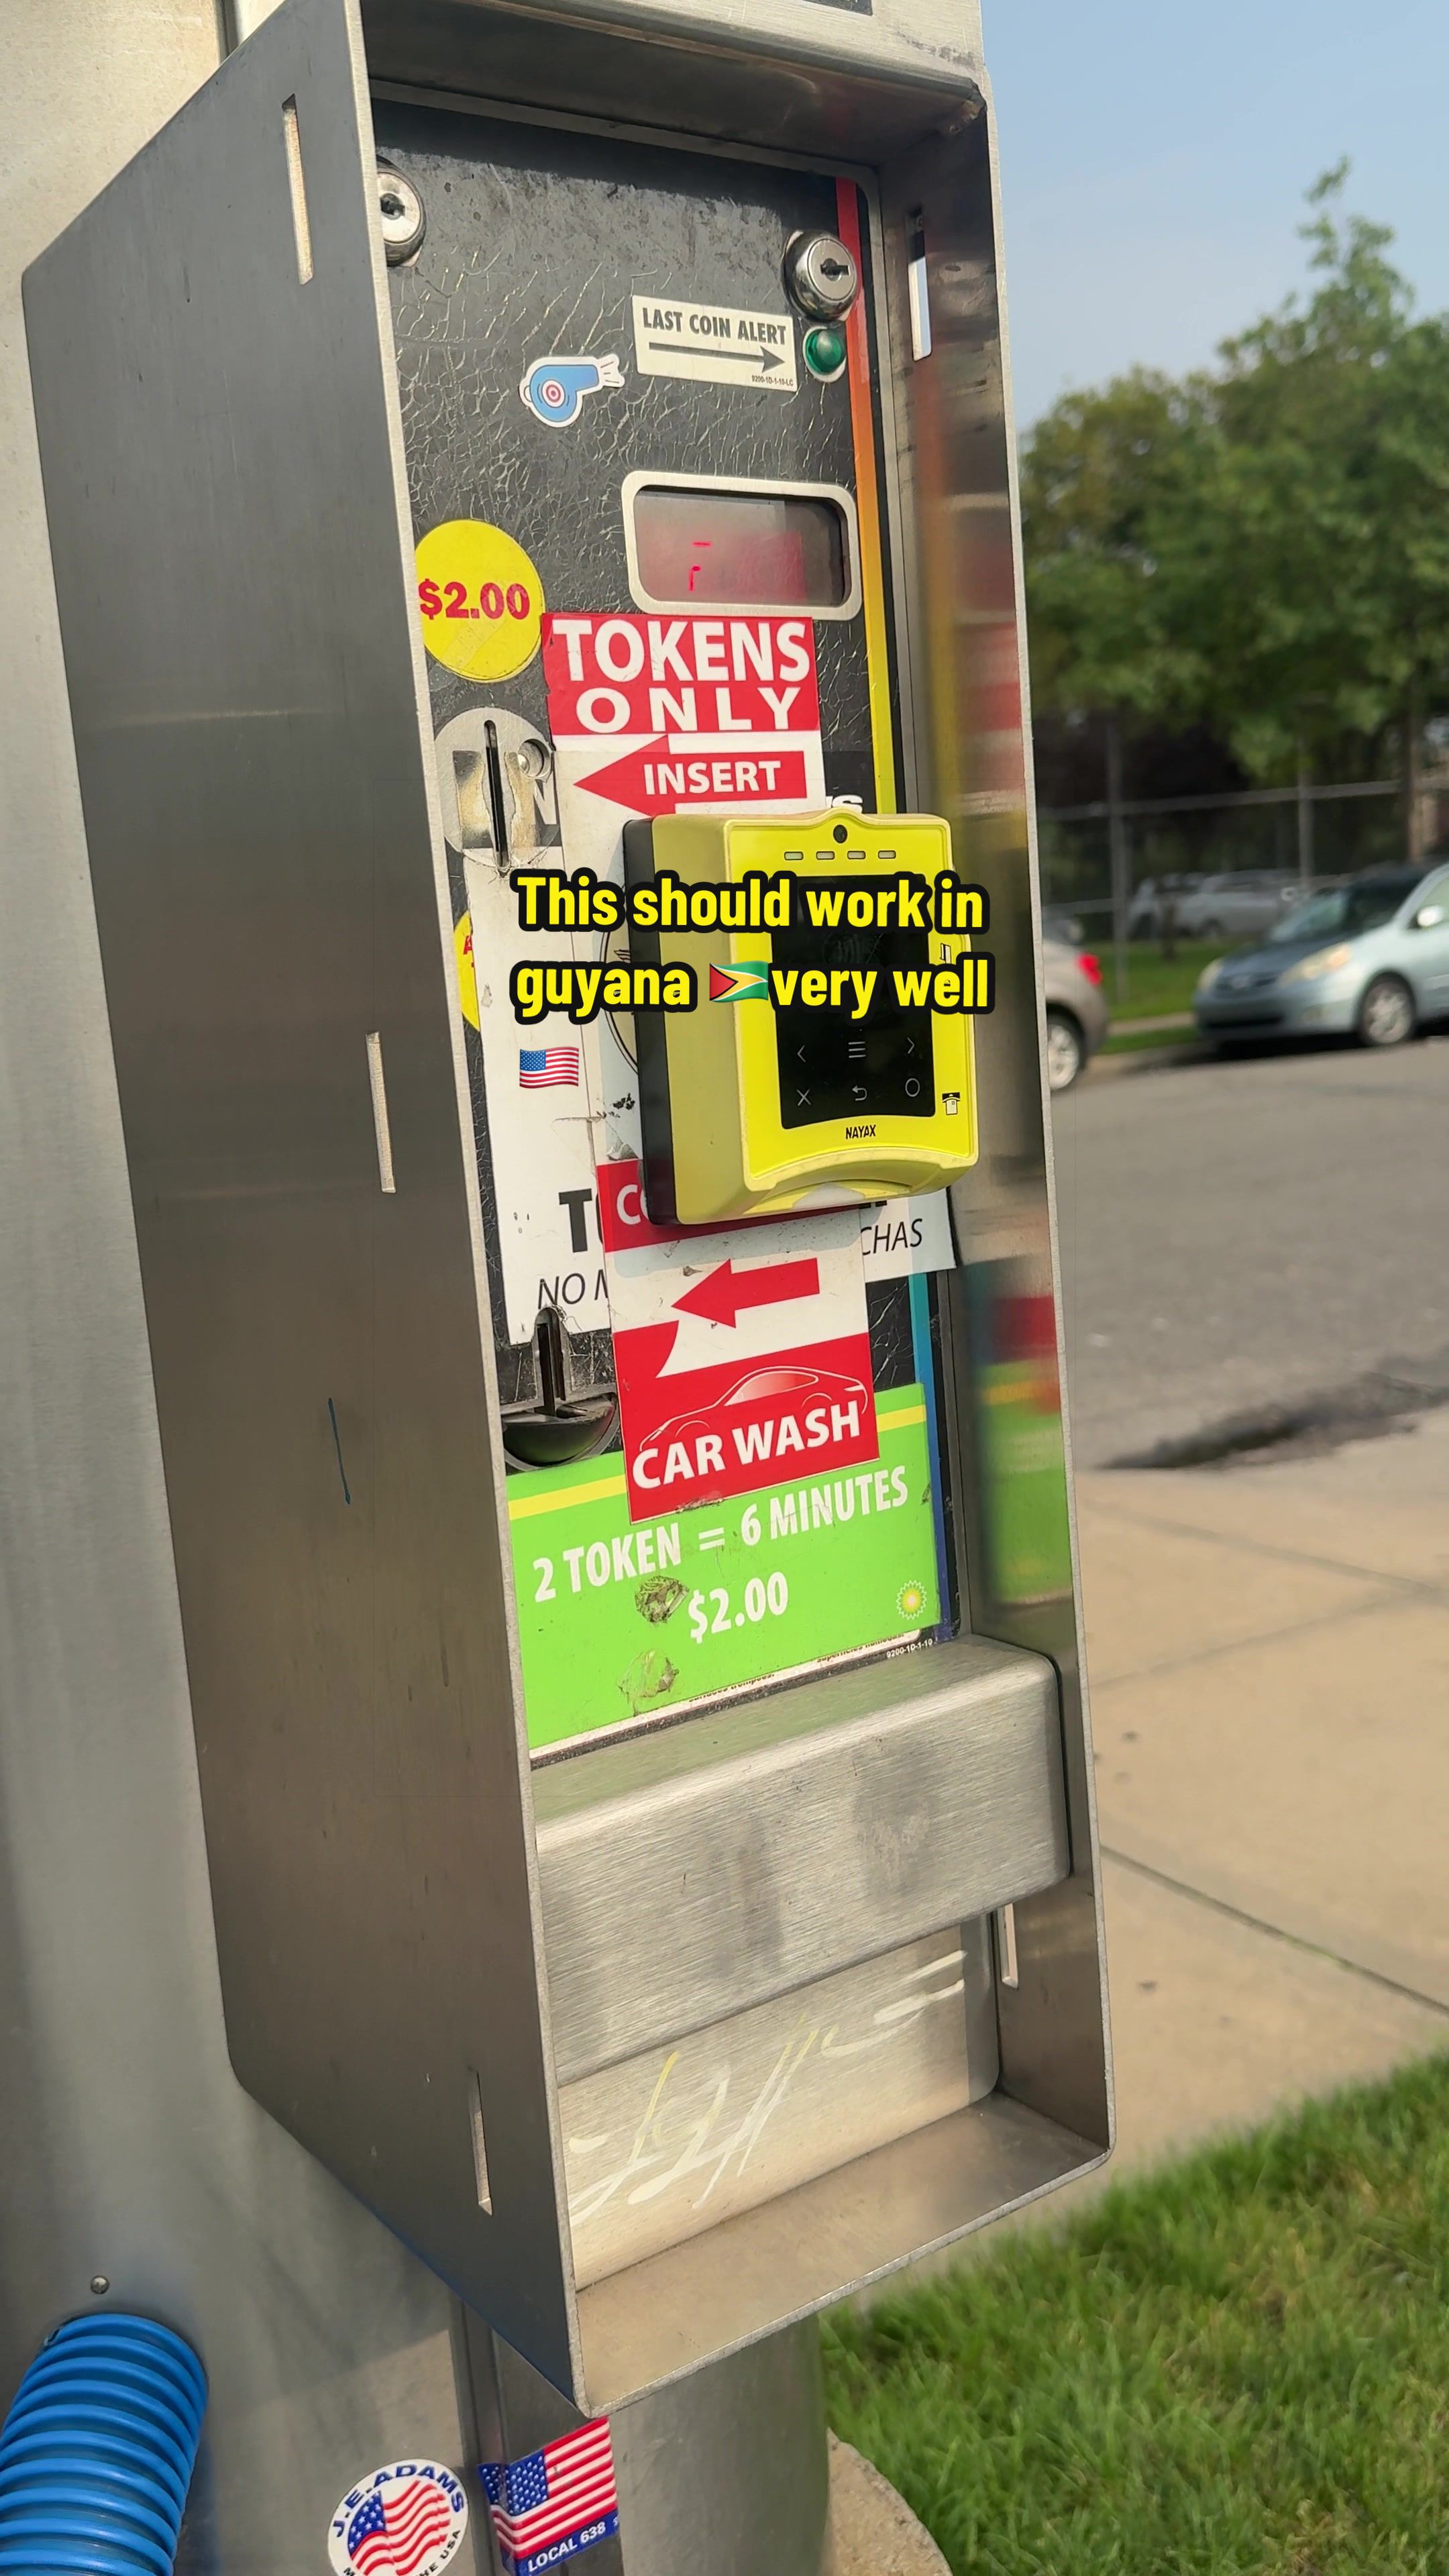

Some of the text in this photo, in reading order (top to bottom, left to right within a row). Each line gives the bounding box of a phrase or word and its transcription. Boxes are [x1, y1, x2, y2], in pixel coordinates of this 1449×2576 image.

[643, 307, 786, 345] LAST COIN ALERT
[418, 578, 530, 620] $2.00
[552, 619, 810, 683] TOKENS
[576, 687, 801, 734] ONLY
[643, 761, 782, 796] INSERT
[845, 1124, 876, 1140] NAYAX
[538, 1273, 586, 1309] NO
[633, 1400, 861, 1489] CAR WASH
[533, 1558, 556, 1603] 2
[564, 1523, 681, 1593] TOKEN
[741, 1504, 761, 1546] 6
[769, 1466, 908, 1540] MINUTES
[688, 1572, 788, 1644] $2.00
[439, 2530, 462, 2559] USA
[527, 2522, 606, 2572] LOCAL 638
